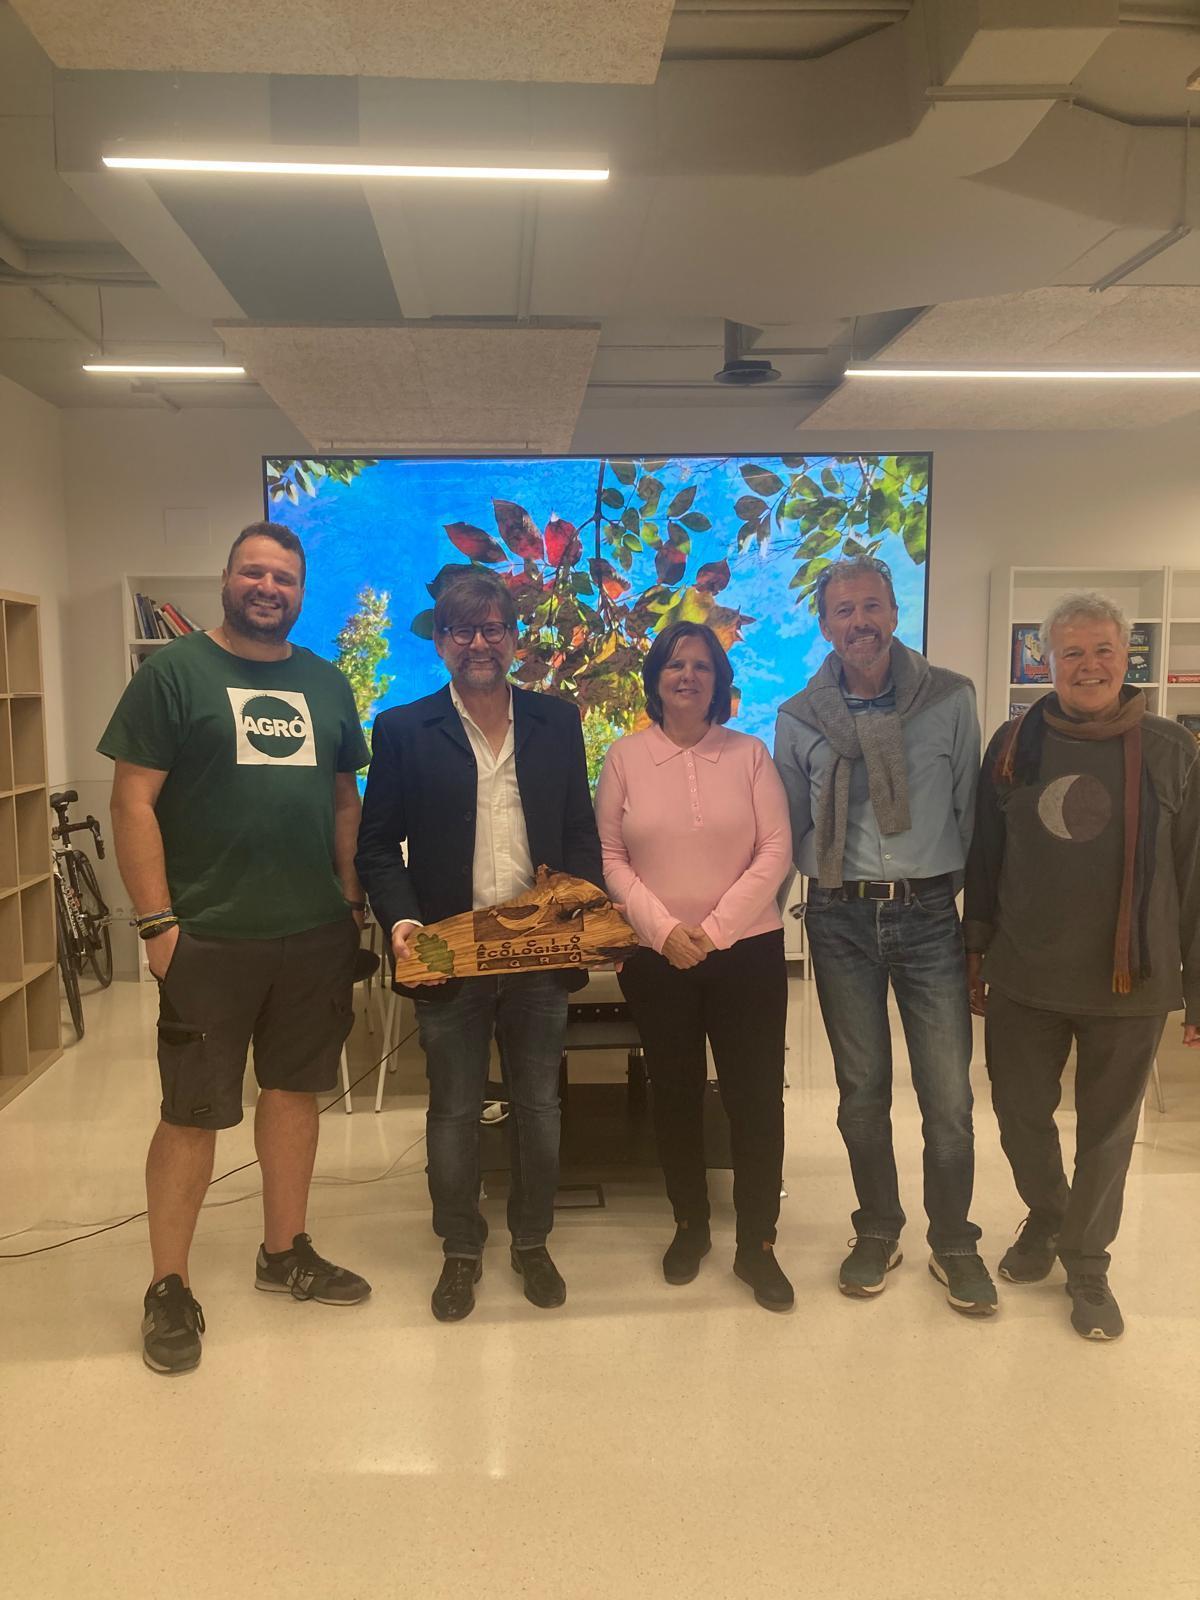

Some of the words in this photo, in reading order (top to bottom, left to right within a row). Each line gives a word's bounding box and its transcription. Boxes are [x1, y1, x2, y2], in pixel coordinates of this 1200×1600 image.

[243, 715, 306, 738] AGRÓ
[477, 944, 580, 958] ECOLOGISTA
[478, 935, 580, 951] ACCIÓ
